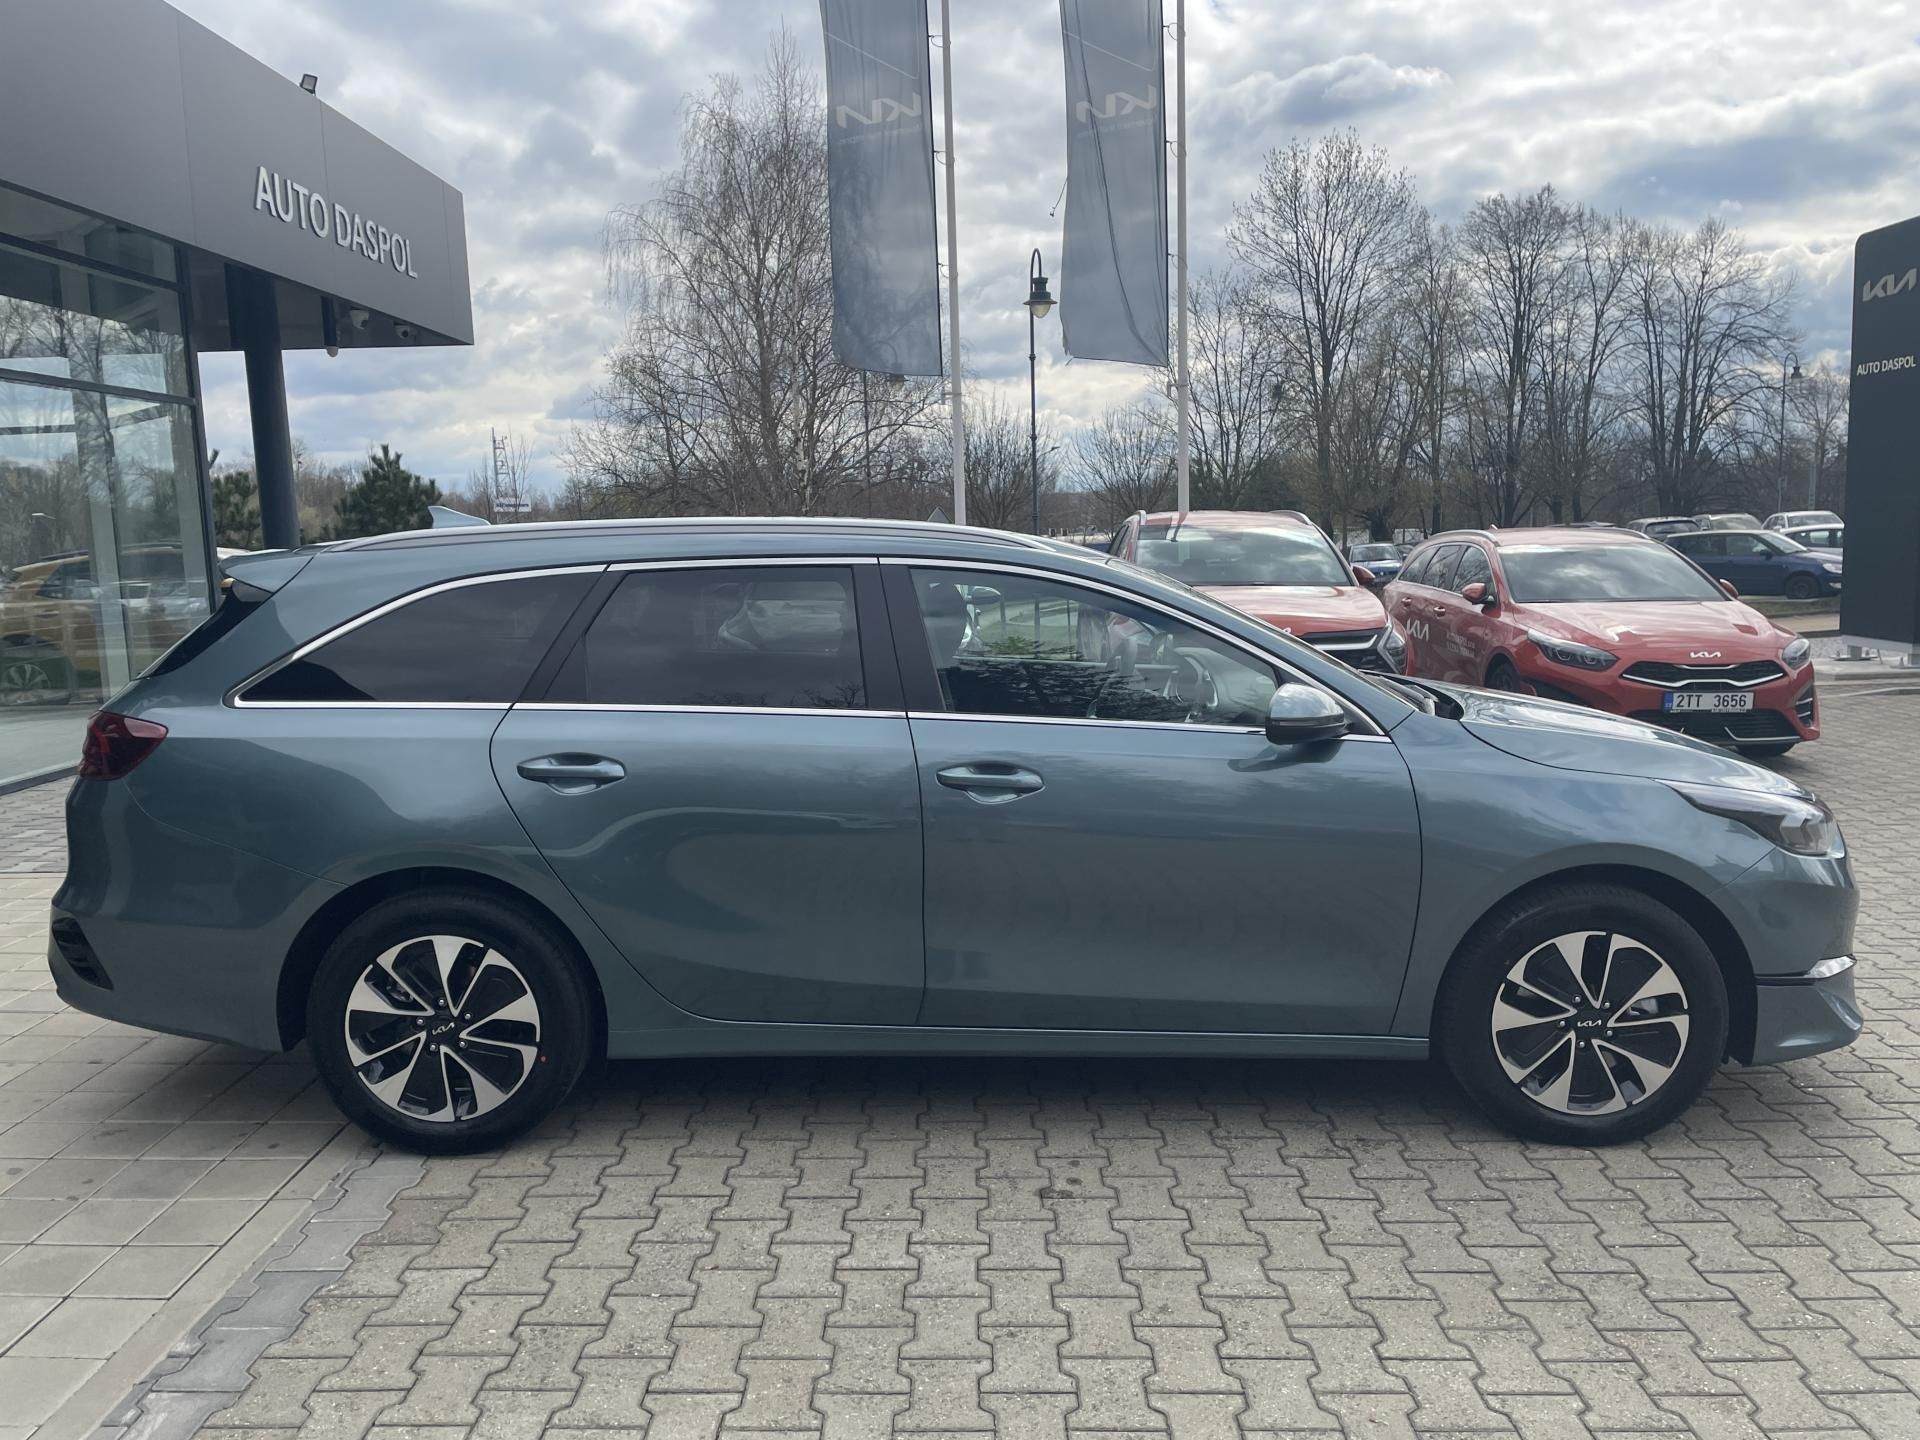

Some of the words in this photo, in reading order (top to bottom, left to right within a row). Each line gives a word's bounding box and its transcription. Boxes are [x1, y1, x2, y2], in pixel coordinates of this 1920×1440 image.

[255, 166, 329, 238] AUTO
[333, 202, 418, 279] DASPOL
[1863, 268, 1917, 302] KIA
[1856, 361, 1880, 377] AUTO
[1881, 355, 1917, 371] DASPOL
[1676, 694, 1703, 708] 2TT
[1713, 694, 1747, 708] 3656
